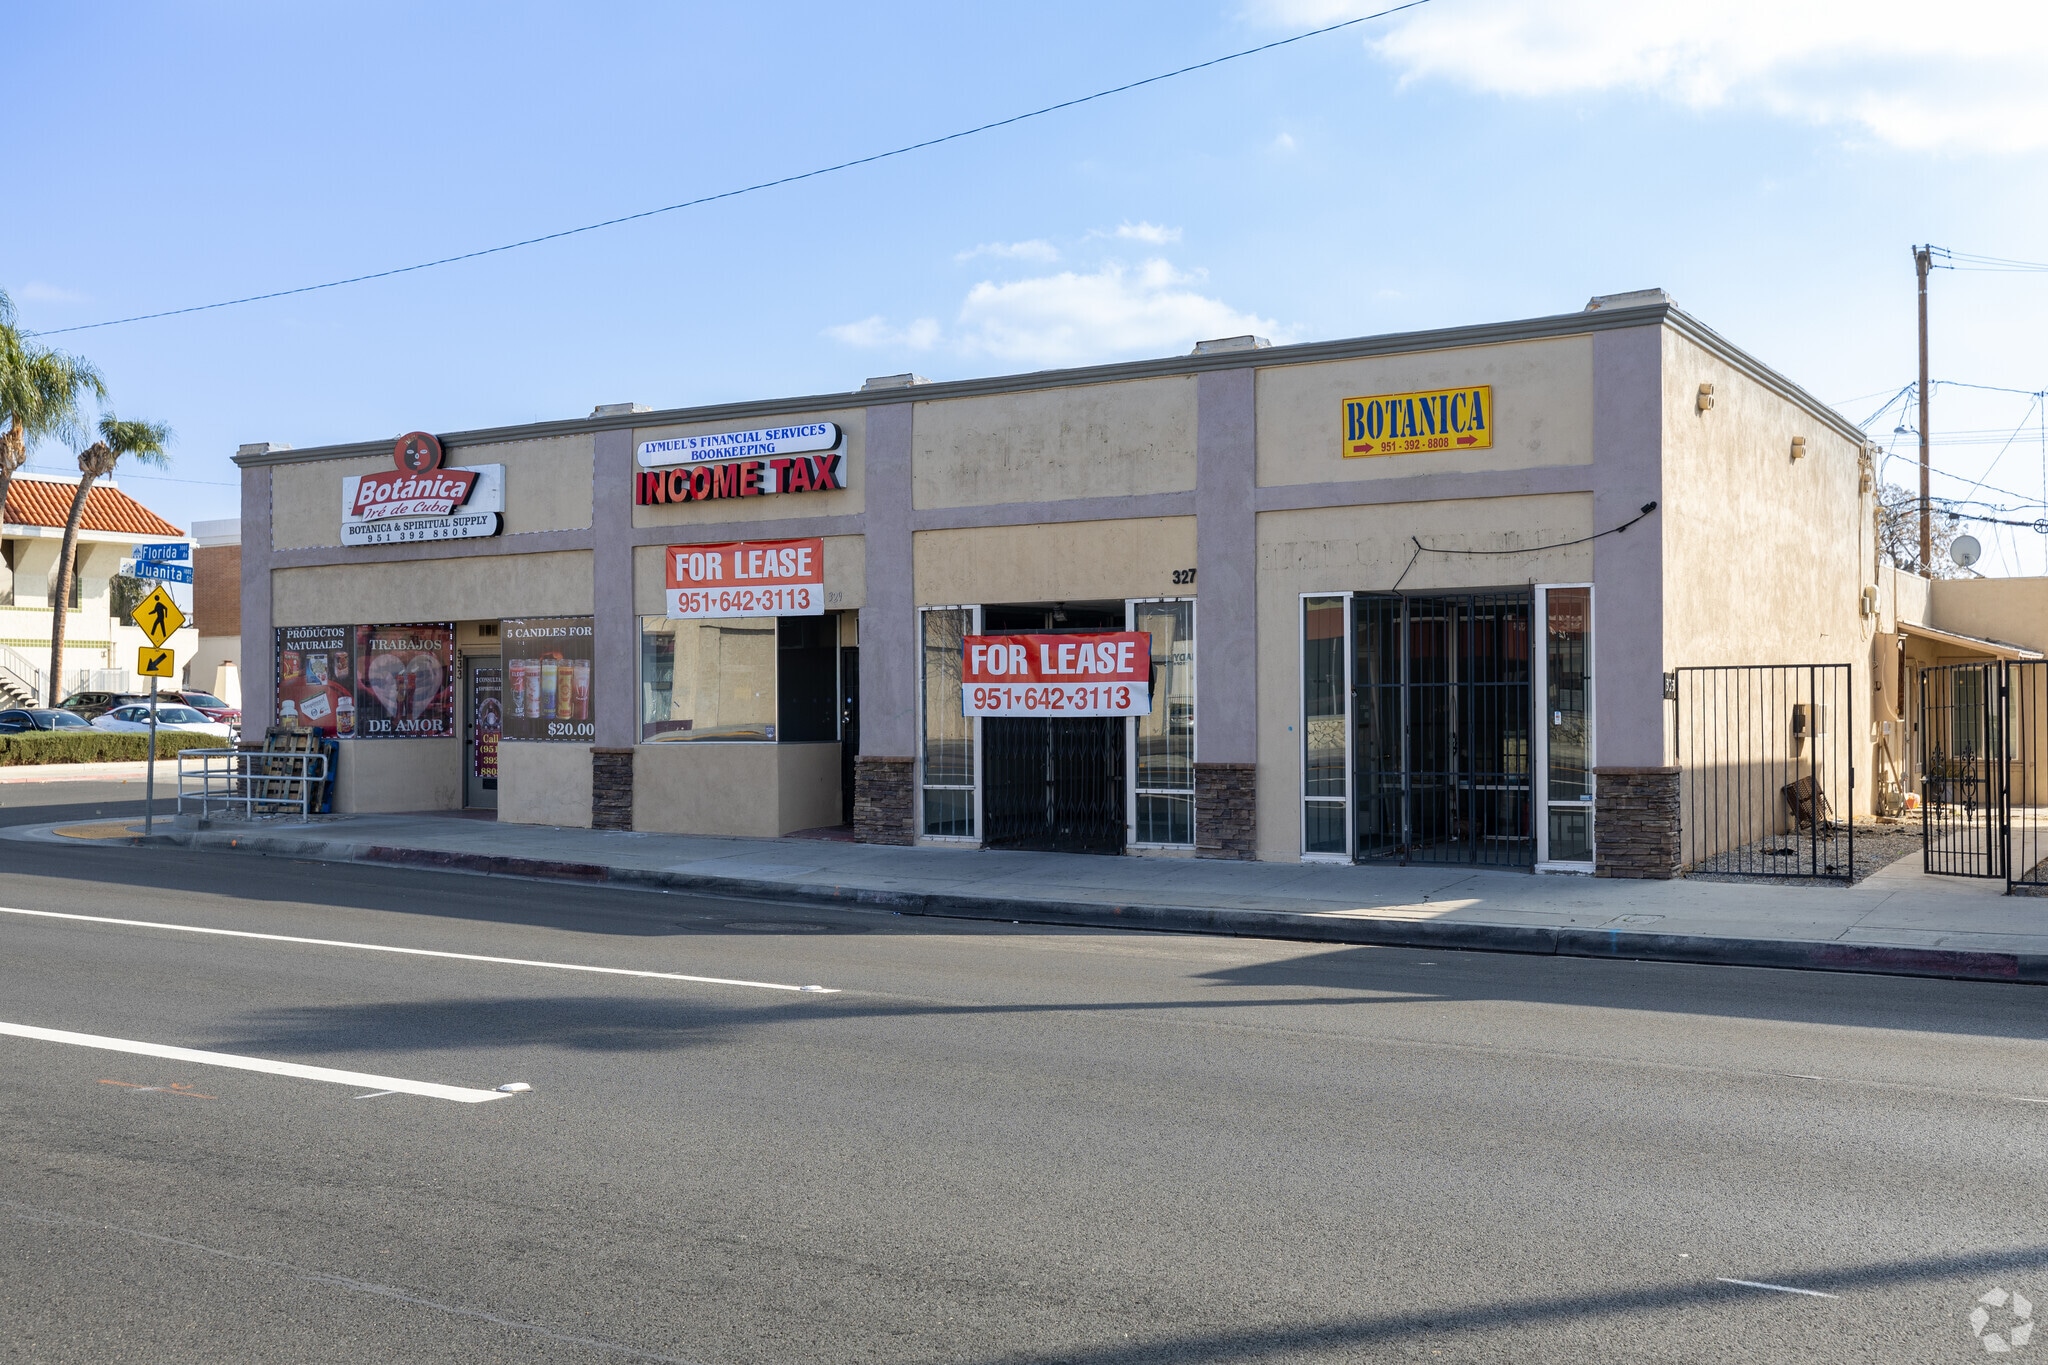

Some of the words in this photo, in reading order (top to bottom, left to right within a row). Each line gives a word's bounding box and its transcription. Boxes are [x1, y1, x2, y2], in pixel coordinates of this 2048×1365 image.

[1347, 391, 1485, 440] BOTANICA
[646, 438, 697, 453] LYMUEL'S
[700, 431, 761, 447] FINANCIAL
[766, 424, 826, 440] SERVICES
[1381, 441, 1396, 452] 951
[1404, 440, 1420, 451] 392
[1427, 438, 1449, 449] 8808
[691, 443, 775, 461] BOOKKEEPING
[636, 461, 762, 505] INCOME
[770, 454, 838, 493] TAX
[358, 474, 467, 506] Botánica
[364, 506, 386, 520] Iré
[390, 502, 409, 515] de
[413, 501, 449, 513] Cuba
[349, 522, 392, 535] BOTANICA
[394, 522, 401, 531] &
[403, 519, 451, 530] SPIRITUAL
[452, 515, 488, 526] SUPPLY
[368, 534, 391, 542] 951
[400, 531, 424, 540] 392
[433, 528, 468, 538] 8808
[142, 546, 177, 559] Florida
[137, 563, 182, 580] Juanita
[675, 552, 723, 582] FOR
[734, 547, 812, 579] LEASE
[1172, 568, 1197, 584] 327
[286, 628, 345, 639] PRODUCTOS
[507, 629, 513, 638] 5
[515, 627, 567, 638] CANDLES
[569, 626, 593, 636] FOR
[286, 640, 344, 651] NATURALES
[369, 639, 442, 650] TRABAJOS
[971, 644, 1028, 675] FOR
[1040, 641, 1135, 674] LEASE
[368, 719, 392, 732] DE
[395, 719, 444, 732] AMOR
[548, 721, 595, 736] $20.00
[483, 733, 499, 743] Call
[481, 767, 498, 776] 880
